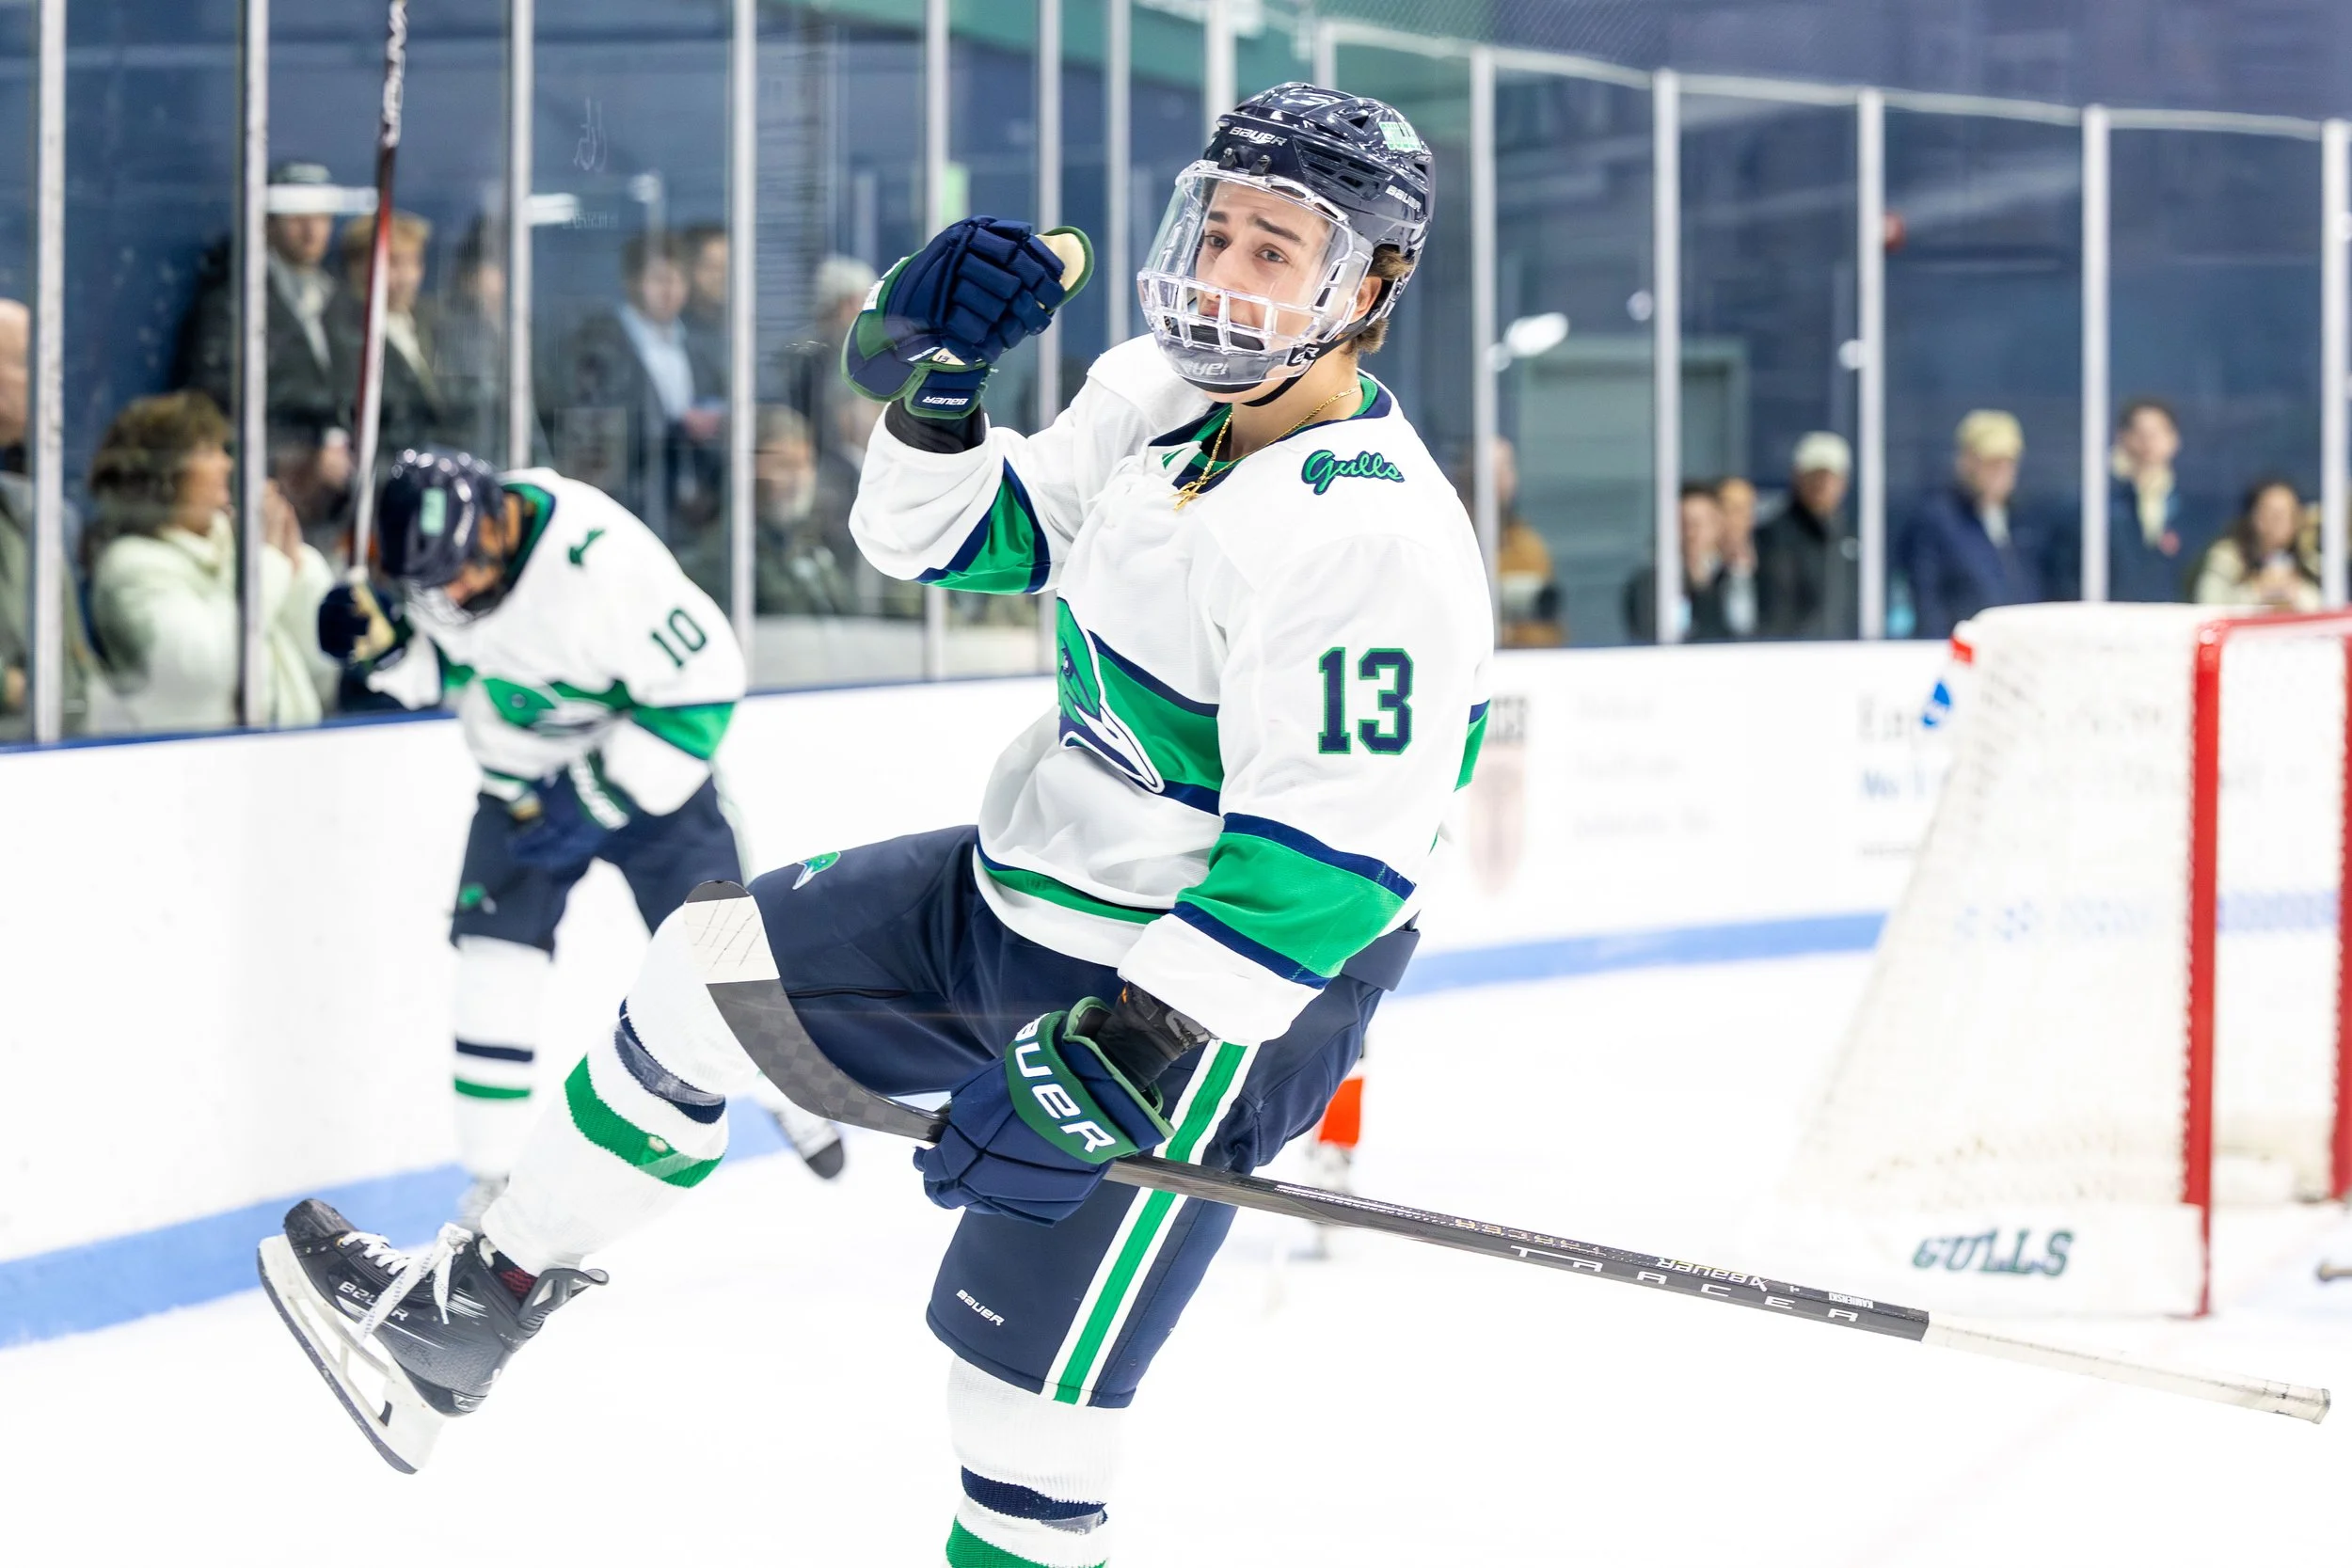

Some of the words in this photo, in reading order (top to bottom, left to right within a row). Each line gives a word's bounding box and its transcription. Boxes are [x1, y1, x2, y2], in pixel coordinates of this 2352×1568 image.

[1229, 127, 1287, 146] BAUER
[922, 396, 968, 405] BAUER
[1302, 450, 1405, 495] Gulls
[651, 607, 707, 668] 10
[1318, 647, 1414, 755] 13
[1015, 1013, 1117, 1153] AUER
[1913, 1227, 2074, 1277] GULLS
[956, 1290, 1005, 1326] BAUER
